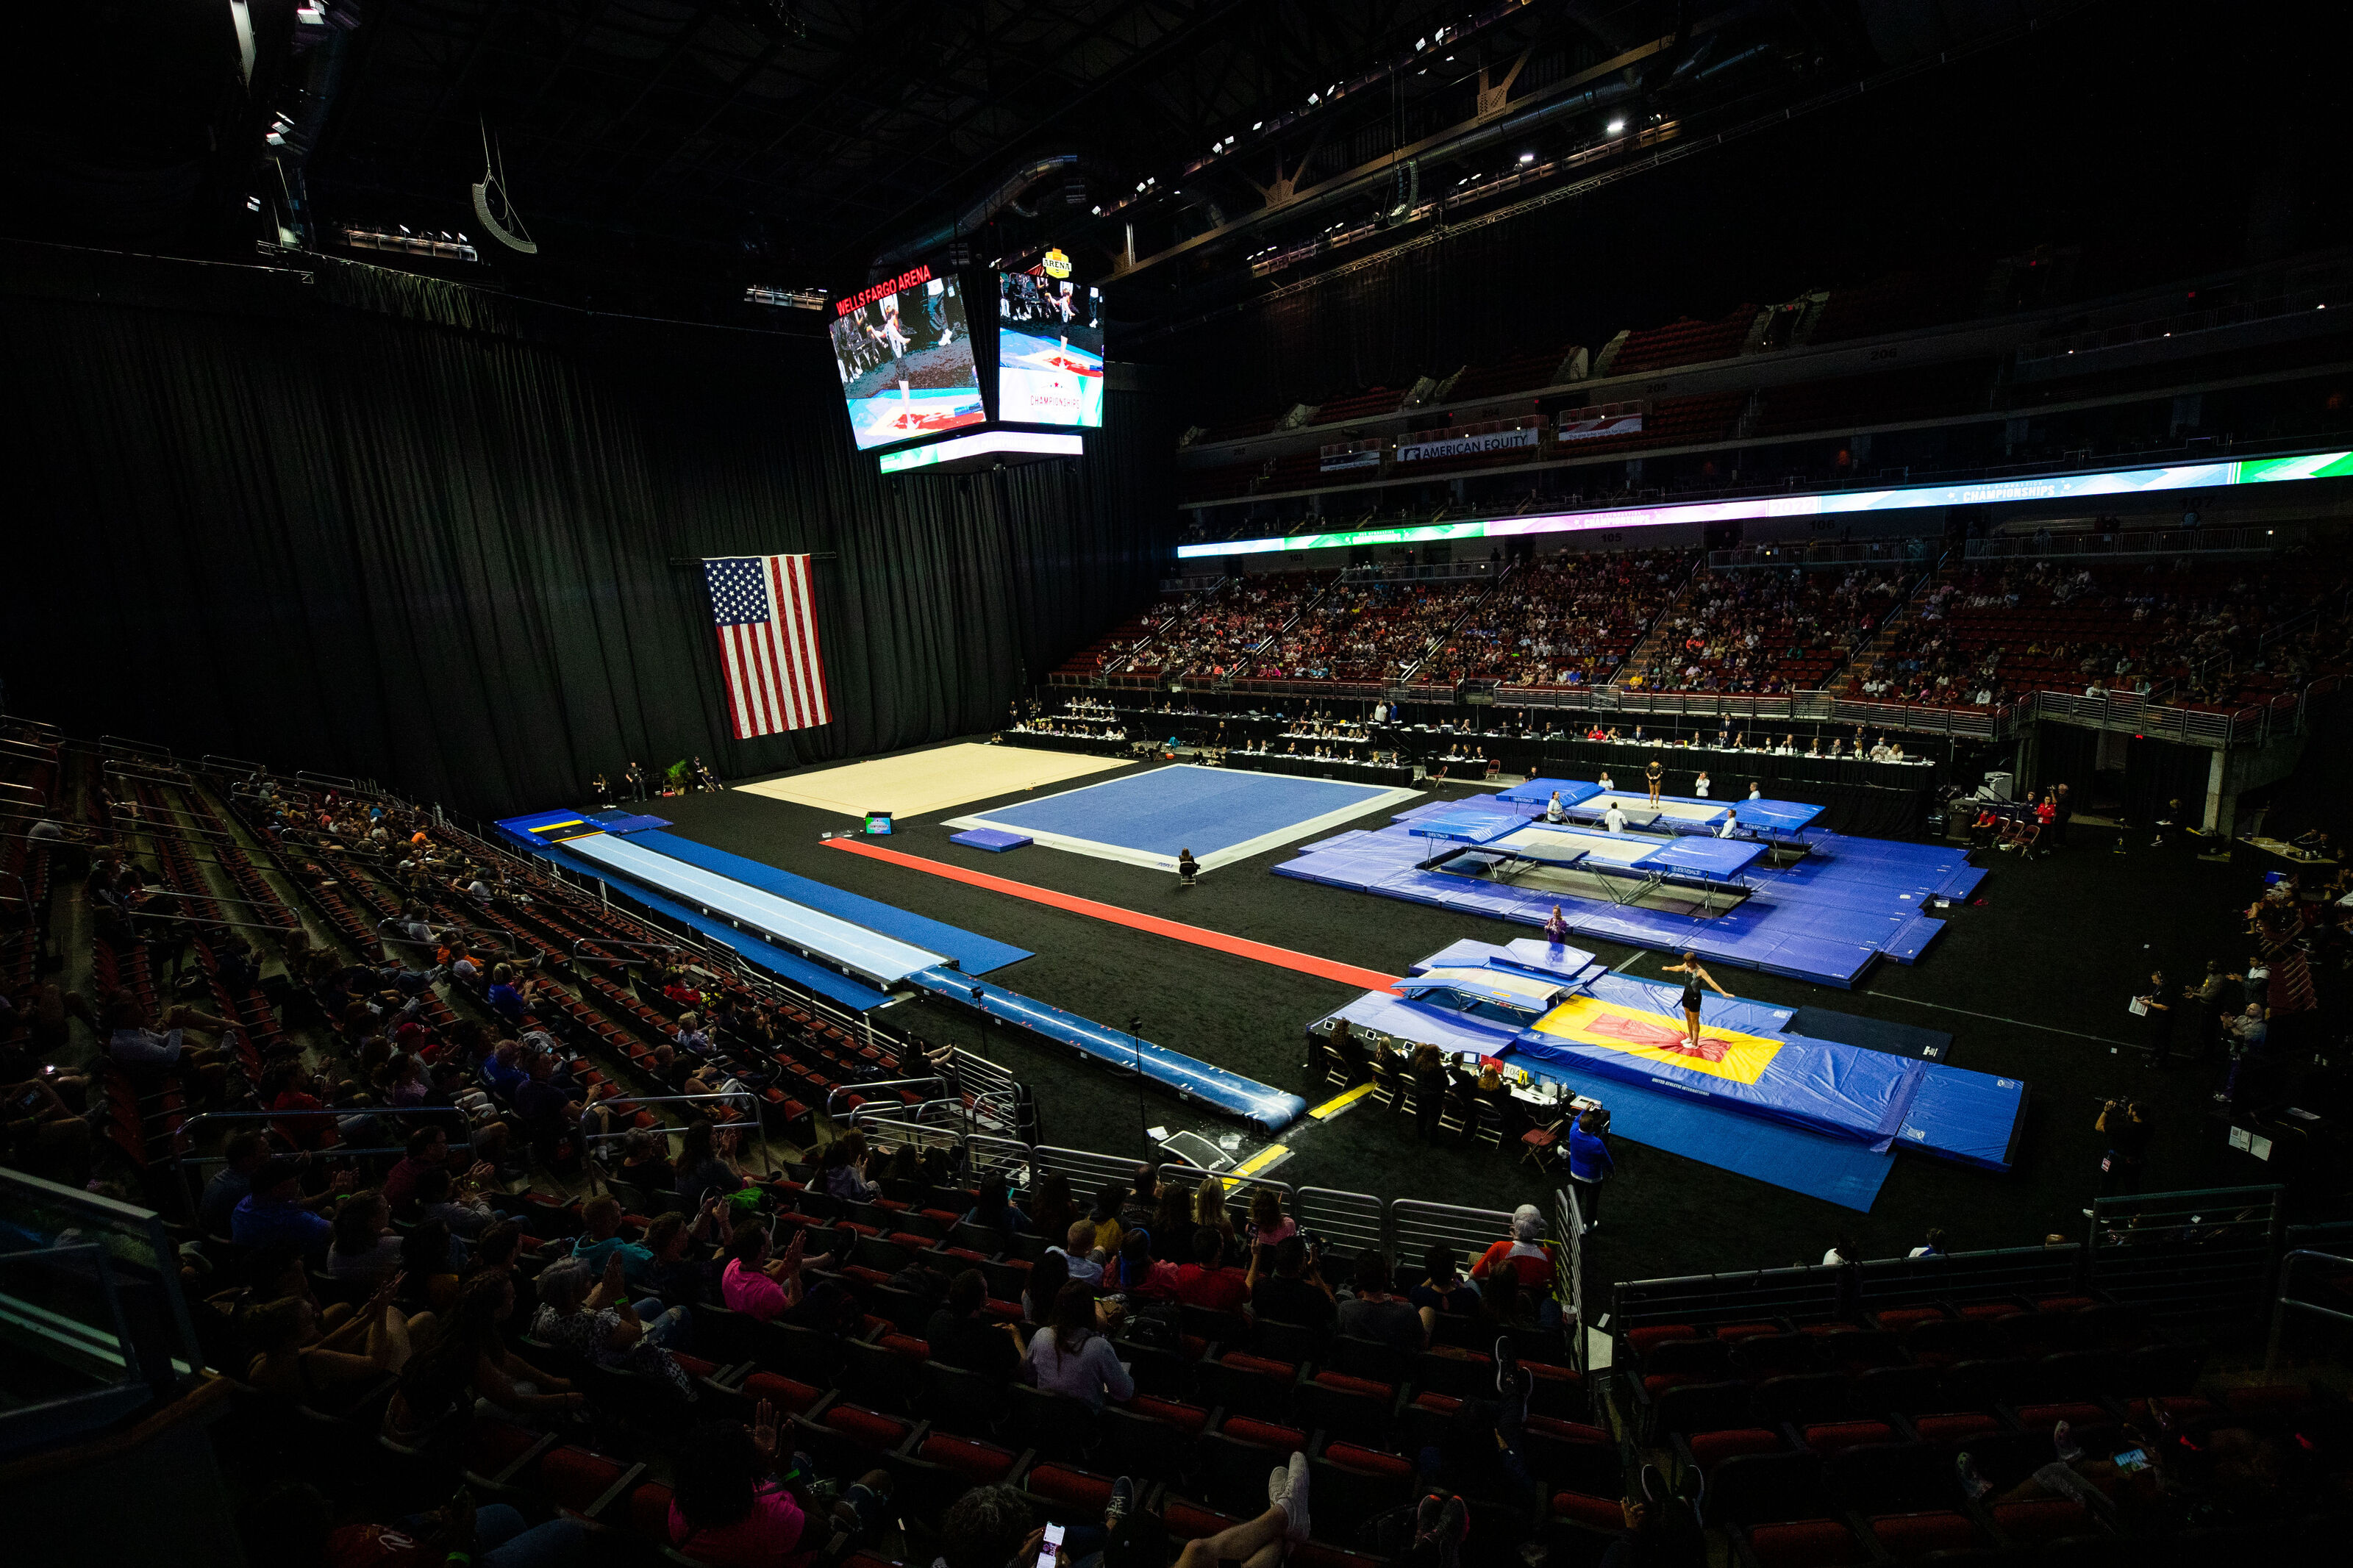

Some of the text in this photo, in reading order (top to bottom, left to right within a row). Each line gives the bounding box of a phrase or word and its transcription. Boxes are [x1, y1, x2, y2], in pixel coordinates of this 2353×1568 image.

[1044, 259, 1070, 270] ARENA
[836, 265, 932, 317] WELLS FARGO ARENA
[1871, 348, 1897, 360] 206
[1030, 395, 1080, 409] CHAMPIONSHIPS
[1423, 434, 1527, 459] AMERICAN EQUITY
[1963, 485, 2055, 502] CHAMPIONSHIPS
[1772, 499, 1815, 514] 2022
[1810, 520, 1835, 531] 106
[1602, 533, 1622, 542] 105
[1390, 547, 1405, 555] 104
[1289, 554, 1304, 562] 103
[1505, 1066, 1520, 1076] 104
[1665, 1081, 1682, 1089] ATHLETIC
[1682, 1086, 1710, 1096] INTERNATIONAL
